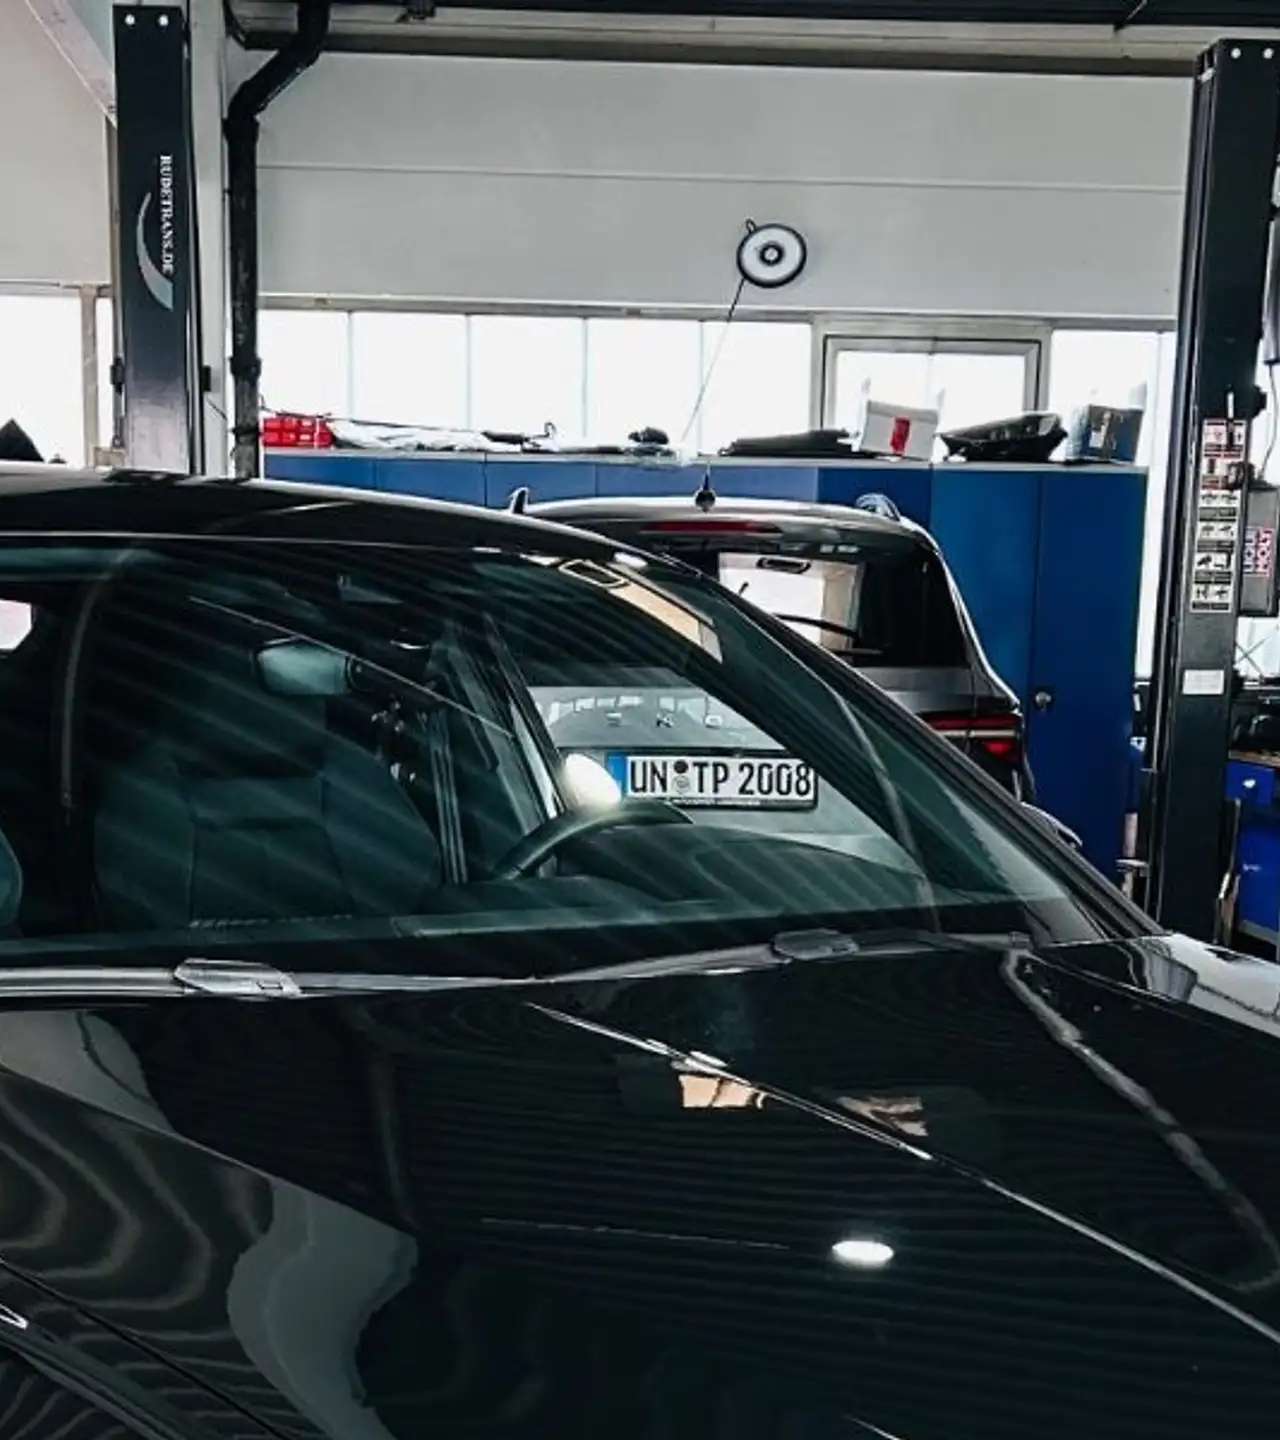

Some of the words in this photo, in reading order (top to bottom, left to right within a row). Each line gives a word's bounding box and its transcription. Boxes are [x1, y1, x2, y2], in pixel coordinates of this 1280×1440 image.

[630, 761, 668, 794] UN
[693, 762, 730, 795] TP
[738, 762, 812, 797] 2008
